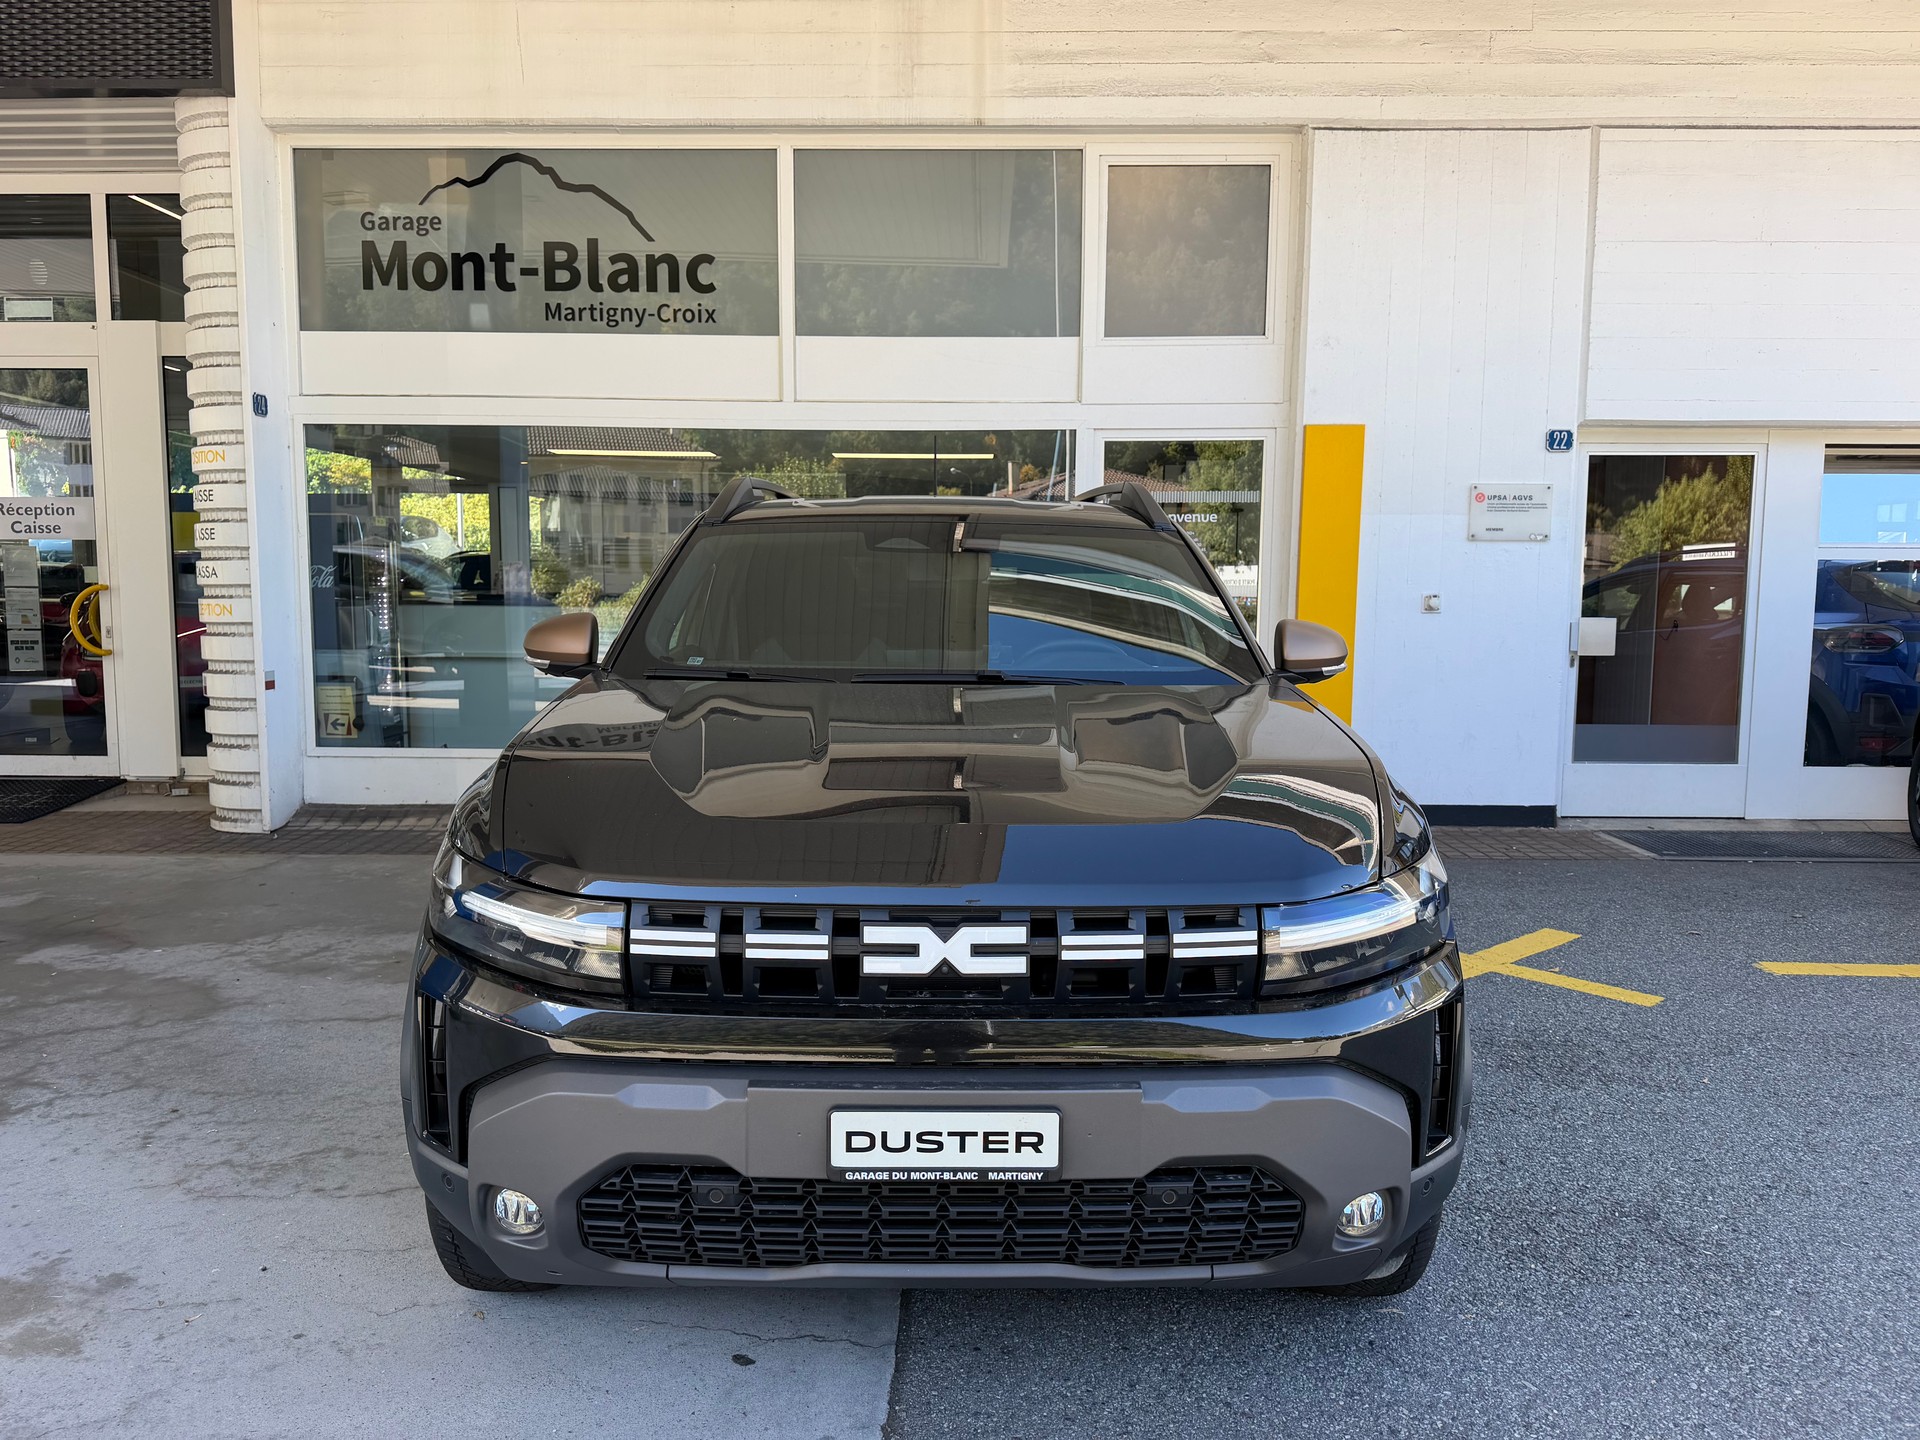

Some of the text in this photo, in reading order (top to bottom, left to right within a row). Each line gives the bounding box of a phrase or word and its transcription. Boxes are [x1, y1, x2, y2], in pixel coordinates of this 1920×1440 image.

[360, 211, 442, 236] Garage
[361, 237, 717, 294] Mont-Blanc
[544, 301, 717, 328] Martigny-Croix
[1553, 431, 1568, 449] 22
[0, 503, 75, 519] Réception
[11, 520, 61, 534] Caisse
[845, 1131, 1044, 1153] DUSTER
[845, 1171, 1044, 1181] GARAGE DU MONT-BLANC MARTIGNY
